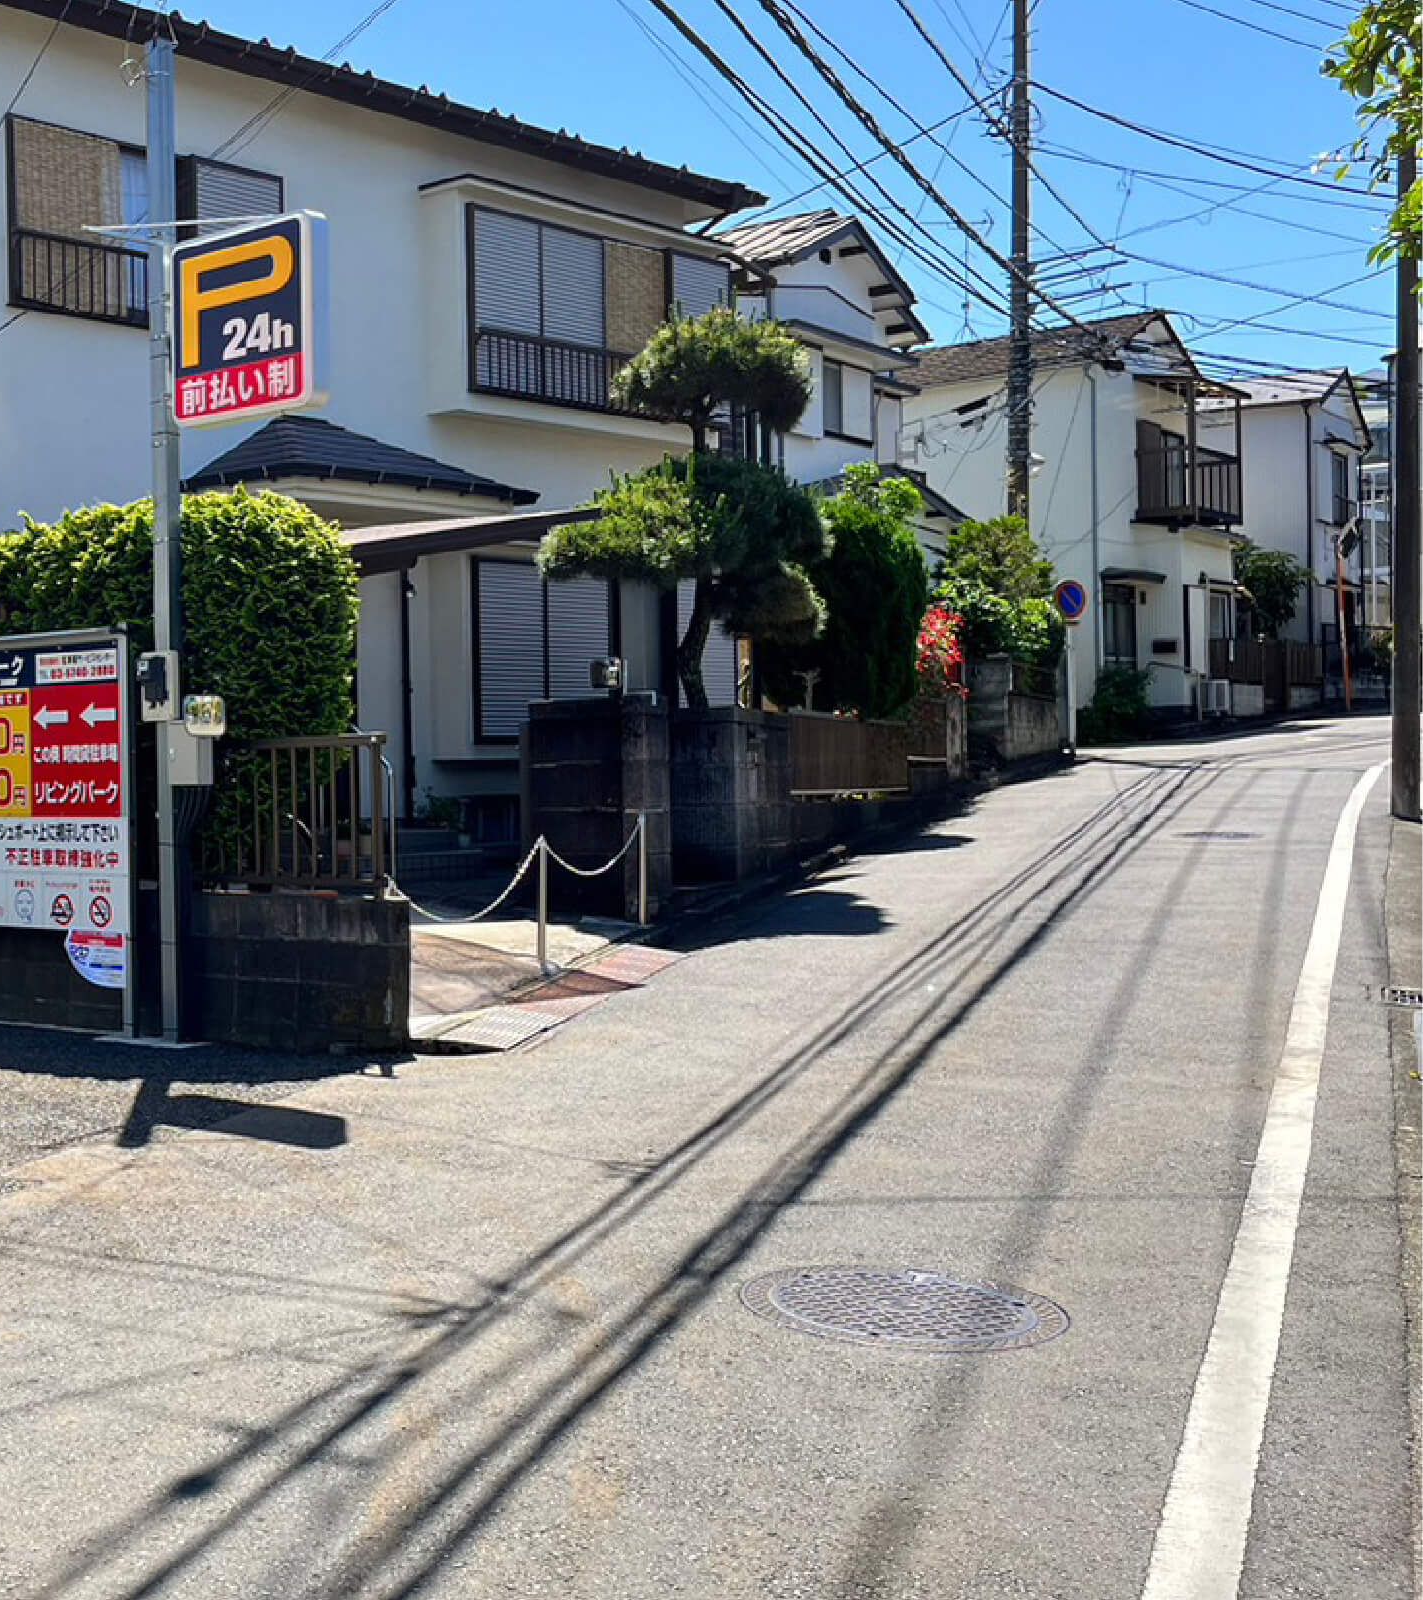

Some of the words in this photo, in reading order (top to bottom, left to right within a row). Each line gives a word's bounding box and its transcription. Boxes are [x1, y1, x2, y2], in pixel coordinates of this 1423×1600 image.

[181, 235, 294, 368] P
[223, 312, 294, 360] 24h
[181, 357, 295, 416] 前払い制
[34, 779, 119, 804] リビングパーク
